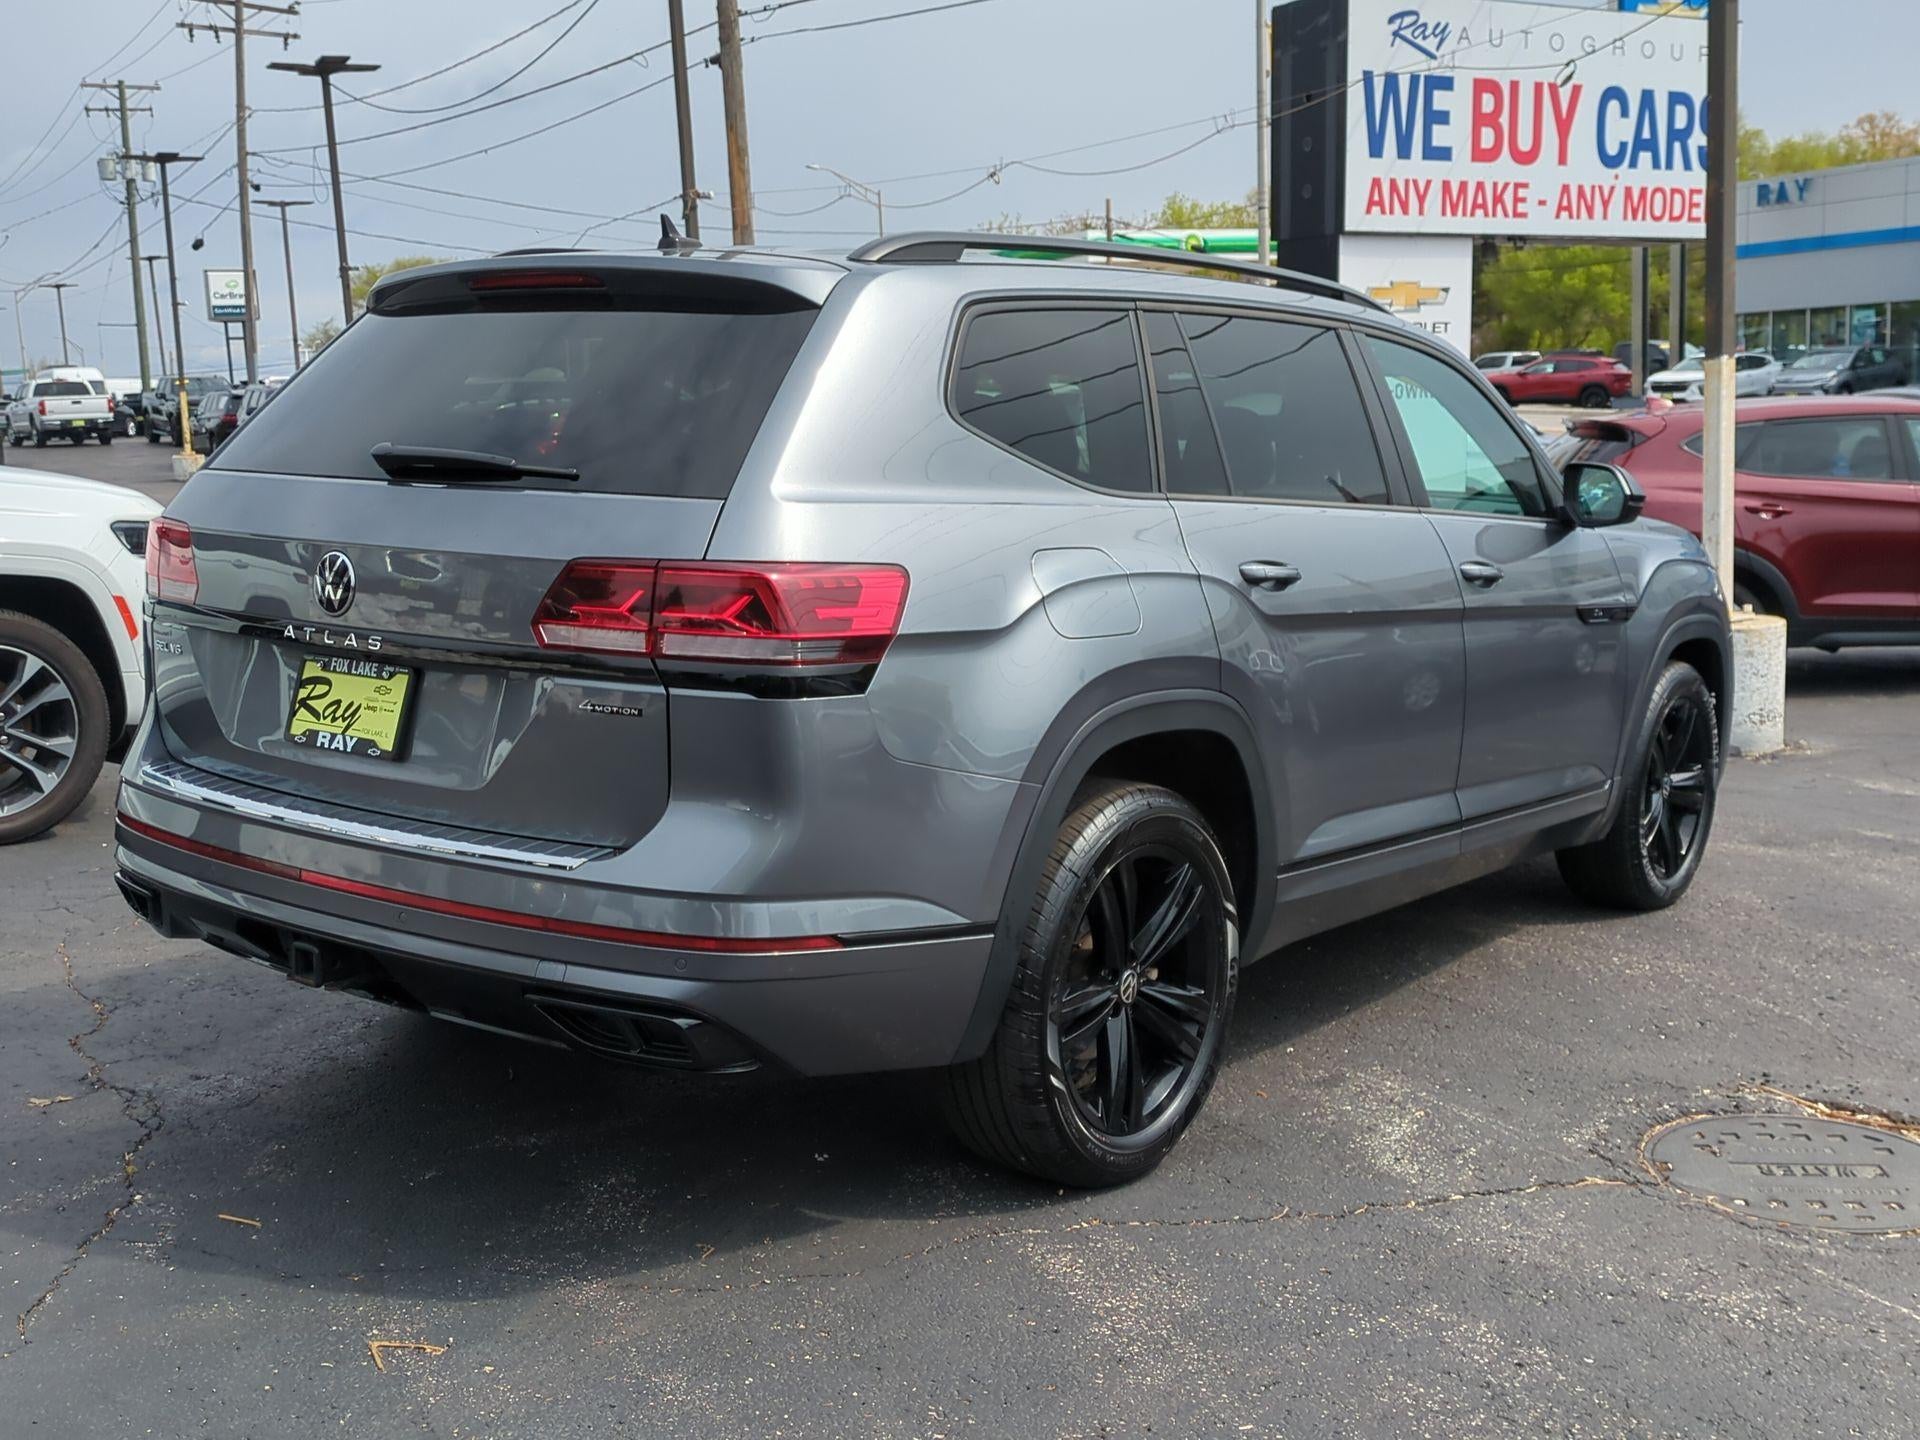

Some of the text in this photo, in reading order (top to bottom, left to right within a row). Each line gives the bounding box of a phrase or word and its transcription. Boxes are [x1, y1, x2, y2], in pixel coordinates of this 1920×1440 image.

[1388, 10, 1452, 60] Ray
[1363, 70, 1454, 161] WE
[1471, 77, 1583, 166] BUY
[1365, 177, 1432, 216] ANY
[1441, 180, 1530, 218] MAKE
[1555, 184, 1616, 220] ANY
[1623, 186, 1708, 223] MODE
[1756, 177, 1811, 207] RAY
[283, 624, 382, 650] ATLAS
[330, 657, 349, 673] FOX
[351, 660, 379, 677] LAKE
[293, 676, 362, 734] Ray
[579, 699, 640, 716] 4MOTION
[316, 732, 358, 752] RAY
